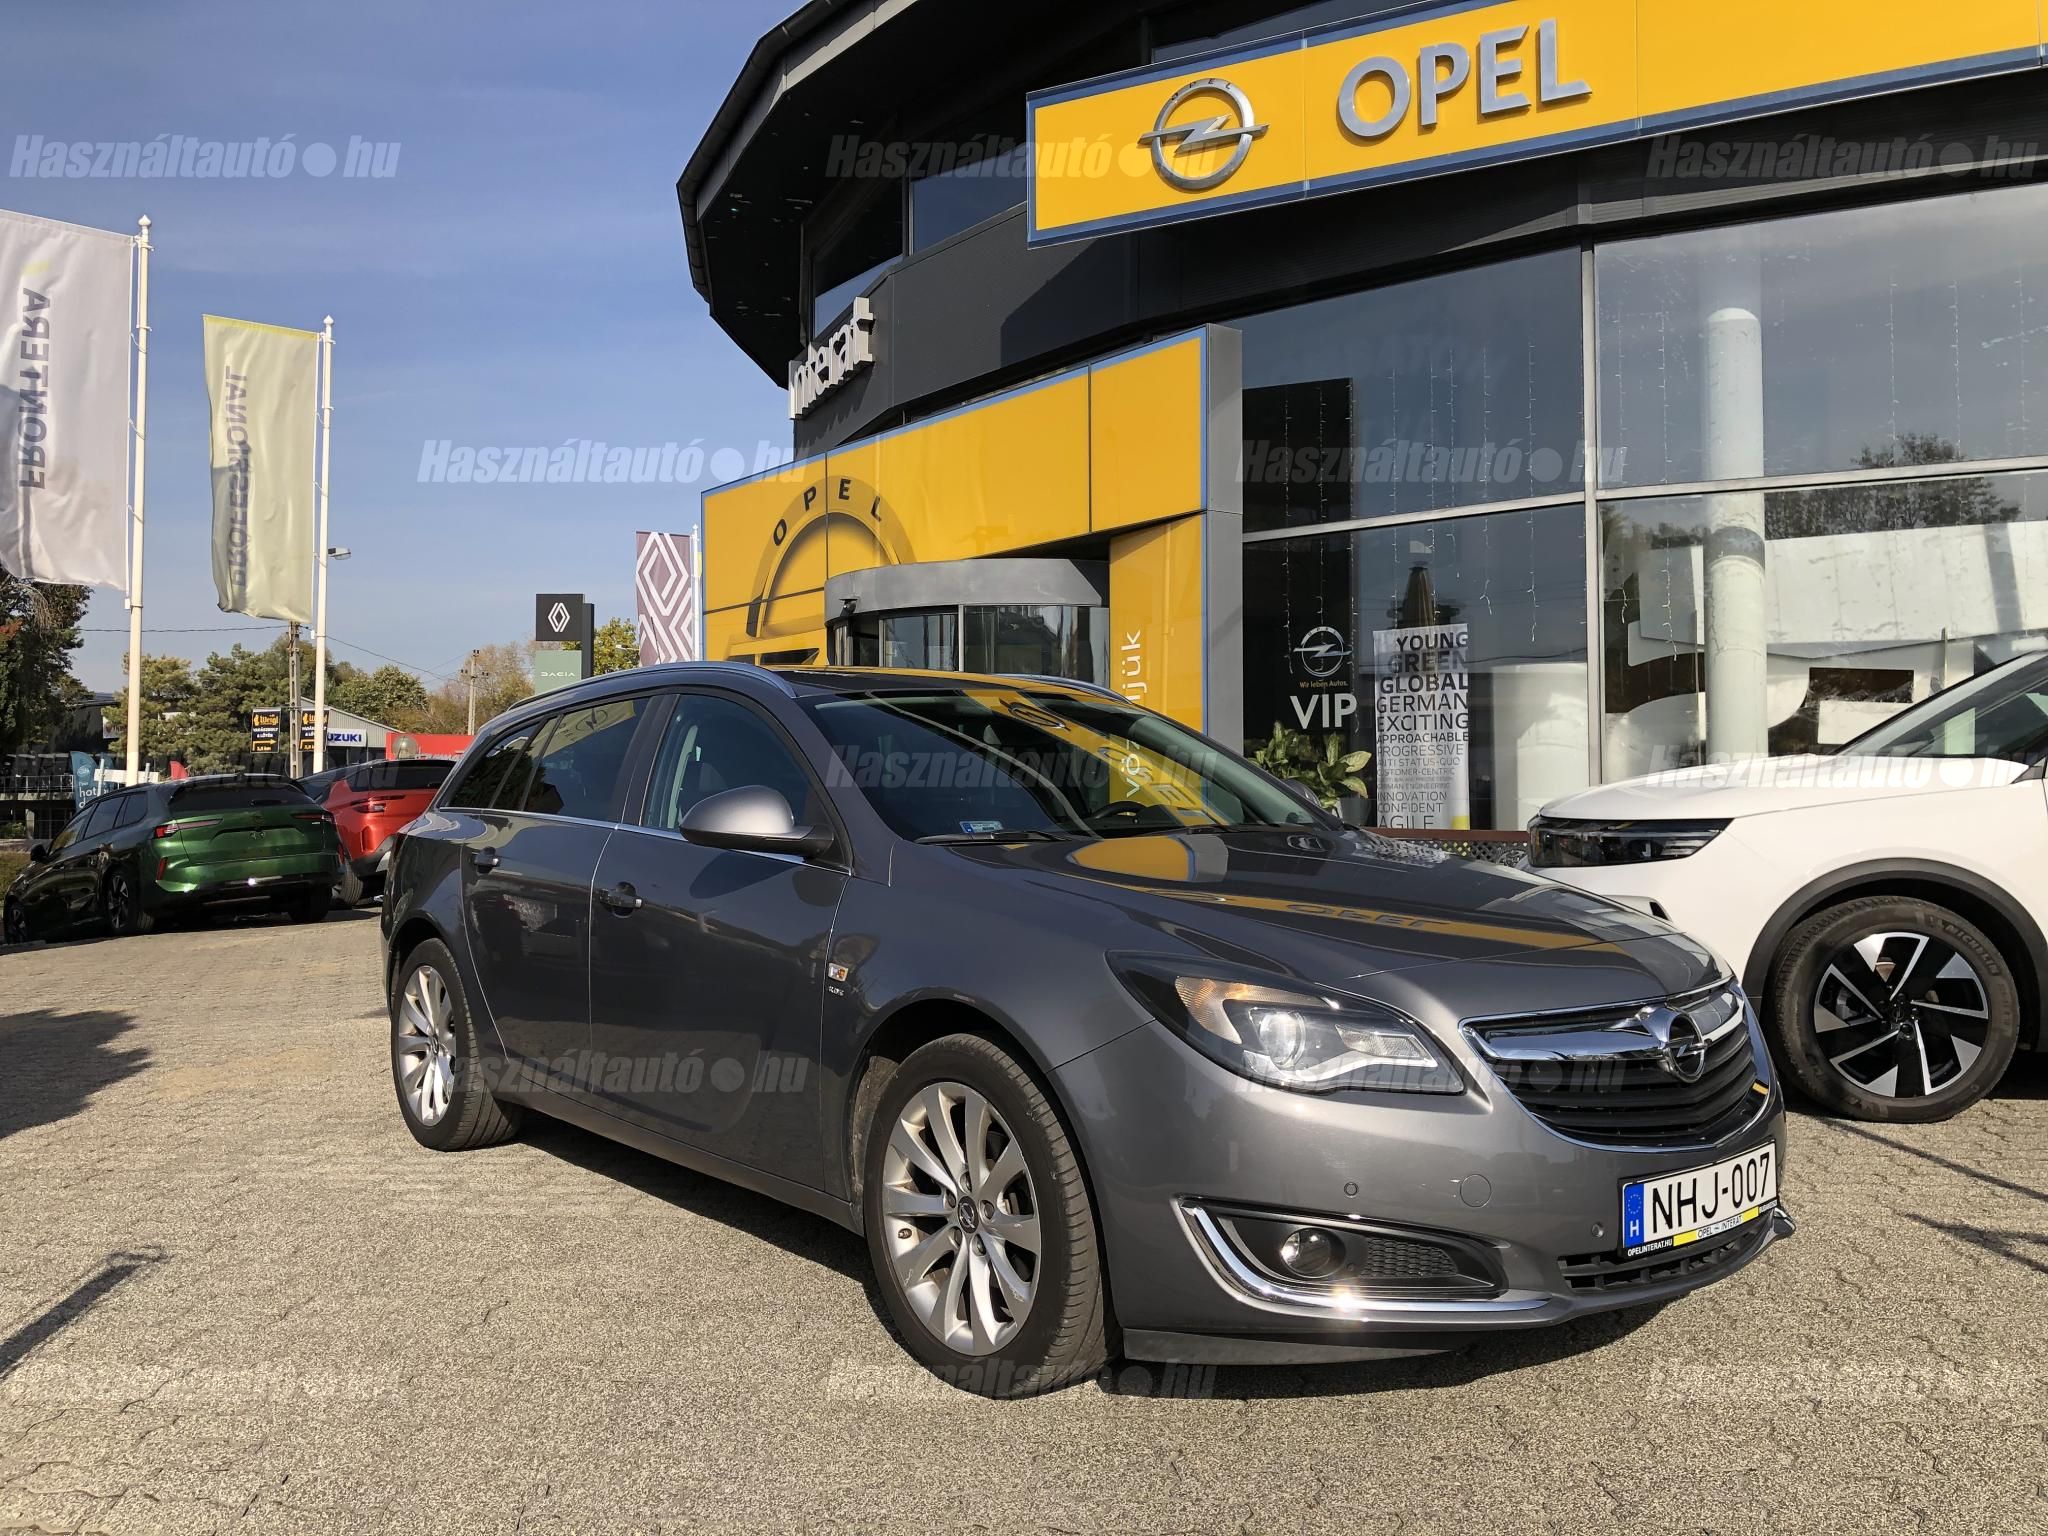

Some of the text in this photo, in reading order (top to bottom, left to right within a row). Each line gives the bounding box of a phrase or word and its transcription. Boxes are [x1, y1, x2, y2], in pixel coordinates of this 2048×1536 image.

[1338, 18, 1592, 138] OPEL
[773, 478, 883, 546] OPEL
[1396, 632, 1469, 652] YOUNG
[1387, 650, 1468, 673] GREEN
[1380, 673, 1469, 694] GLOBAL
[1289, 693, 1357, 729] VIP
[1376, 692, 1468, 714] GERMAN
[1377, 713, 1469, 733] EXCITING
[327, 733, 362, 742] UZUKI
[1376, 732, 1469, 744] APPROACHABLE
[1377, 743, 1464, 757] PROGRESSIVE
[1377, 791, 1448, 801] INNOVATION
[1377, 802, 1444, 813] CONFIDENT
[1652, 1152, 1770, 1234] NHJ-007
[1627, 1215, 1743, 1257] OPELINTERAT.HU OPEL INTERAT
